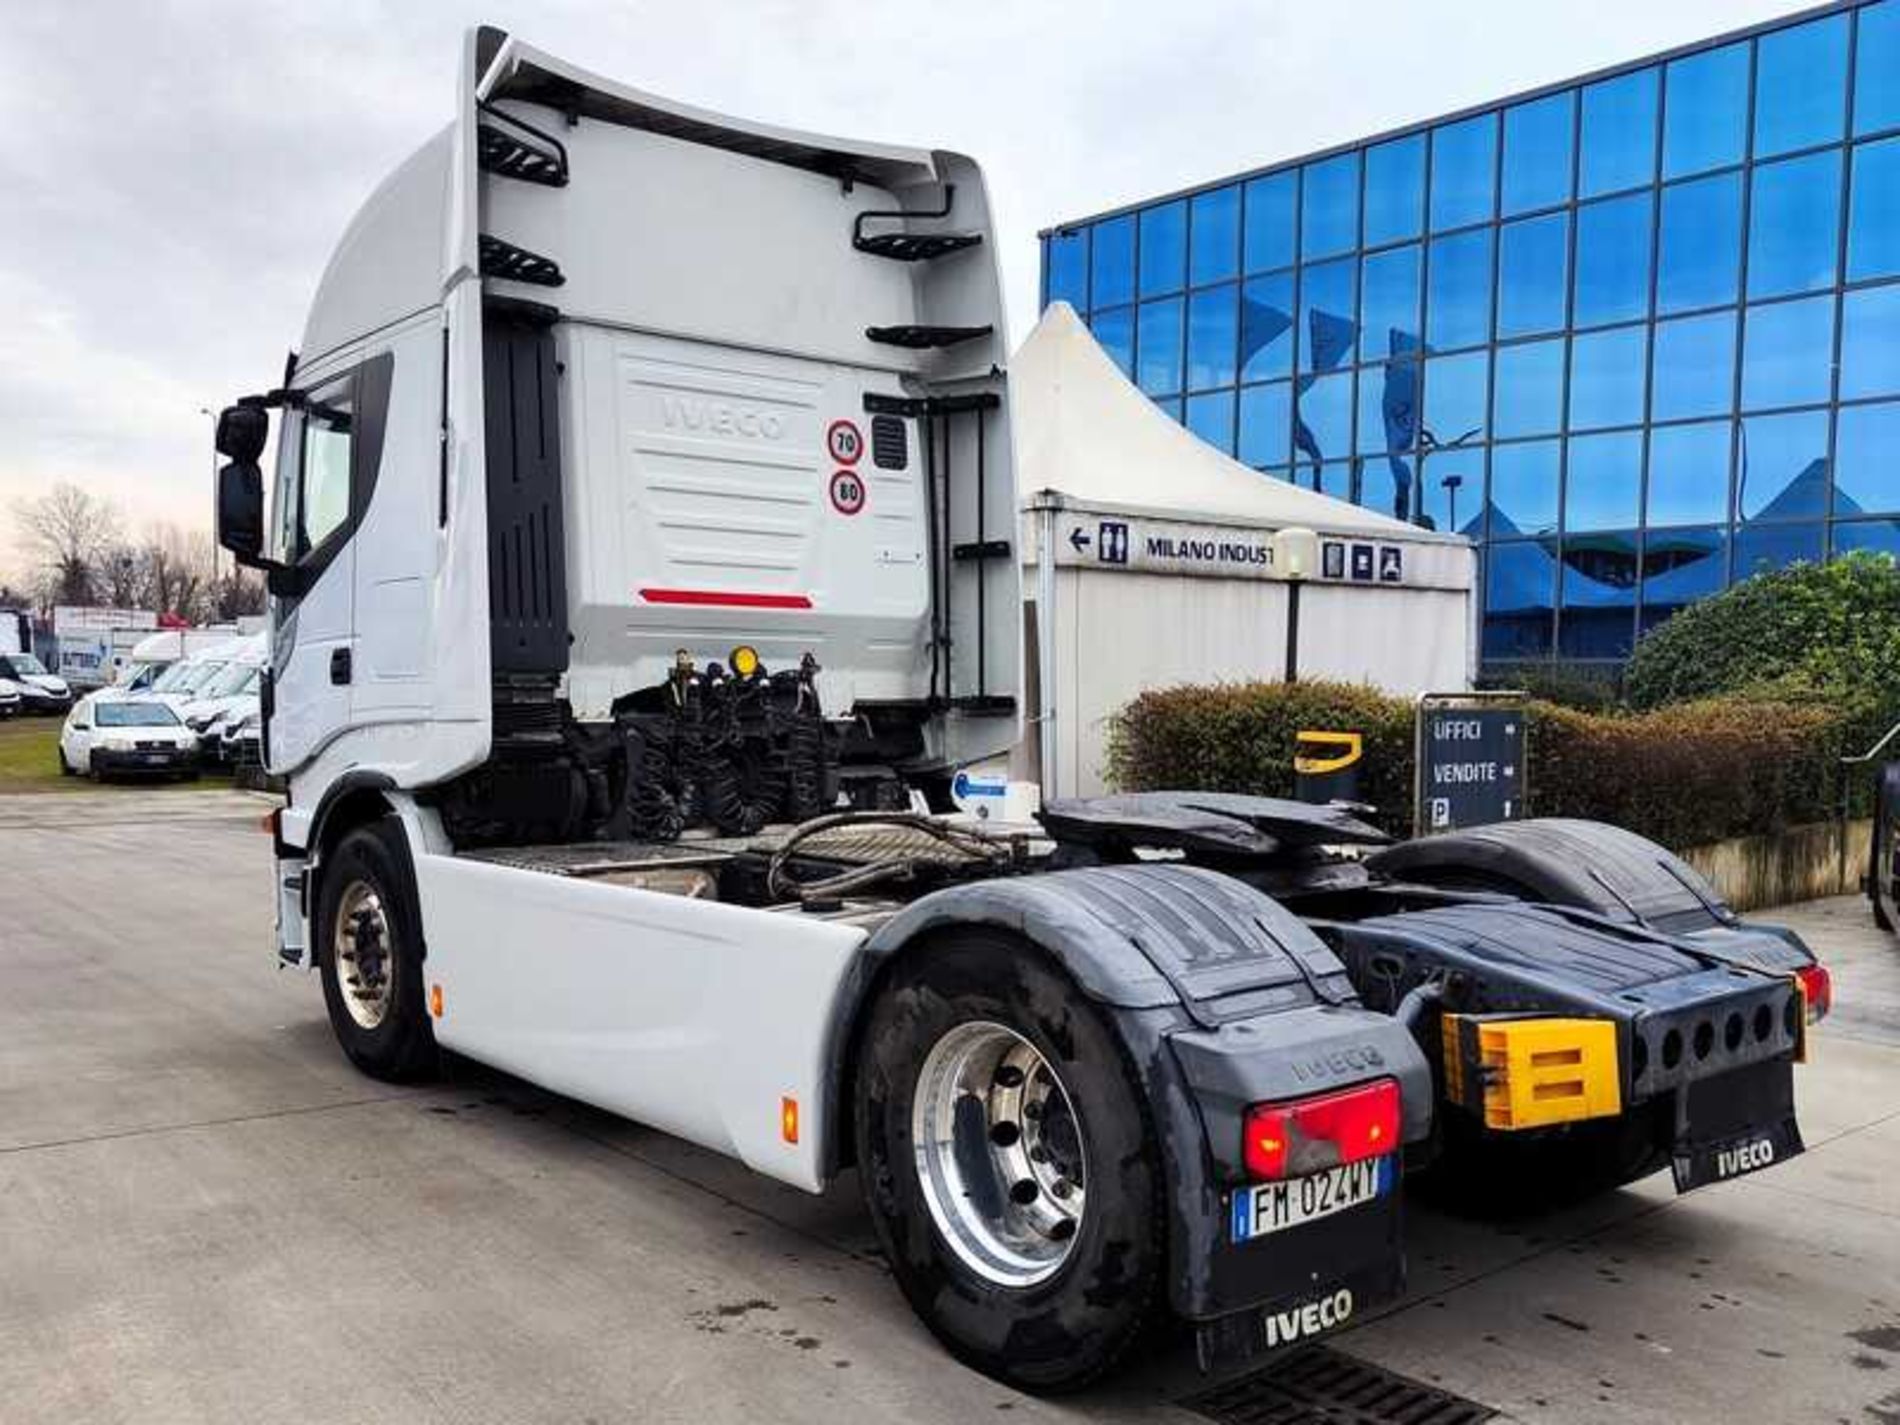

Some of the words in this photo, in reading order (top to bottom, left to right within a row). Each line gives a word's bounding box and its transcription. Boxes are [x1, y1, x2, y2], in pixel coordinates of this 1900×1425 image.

[661, 397, 786, 440] IVECO
[836, 432, 856, 452] 70
[839, 483, 859, 502] 80
[1146, 538, 1215, 561] MILANO
[1433, 721, 1482, 740] UFFICI
[1433, 761, 1497, 783] VENDITE
[1291, 1046, 1385, 1082] IVECO
[1717, 1139, 1774, 1178] IVECO
[1254, 1184, 1290, 1232] FM
[1264, 1288, 1352, 1348] IVECO
